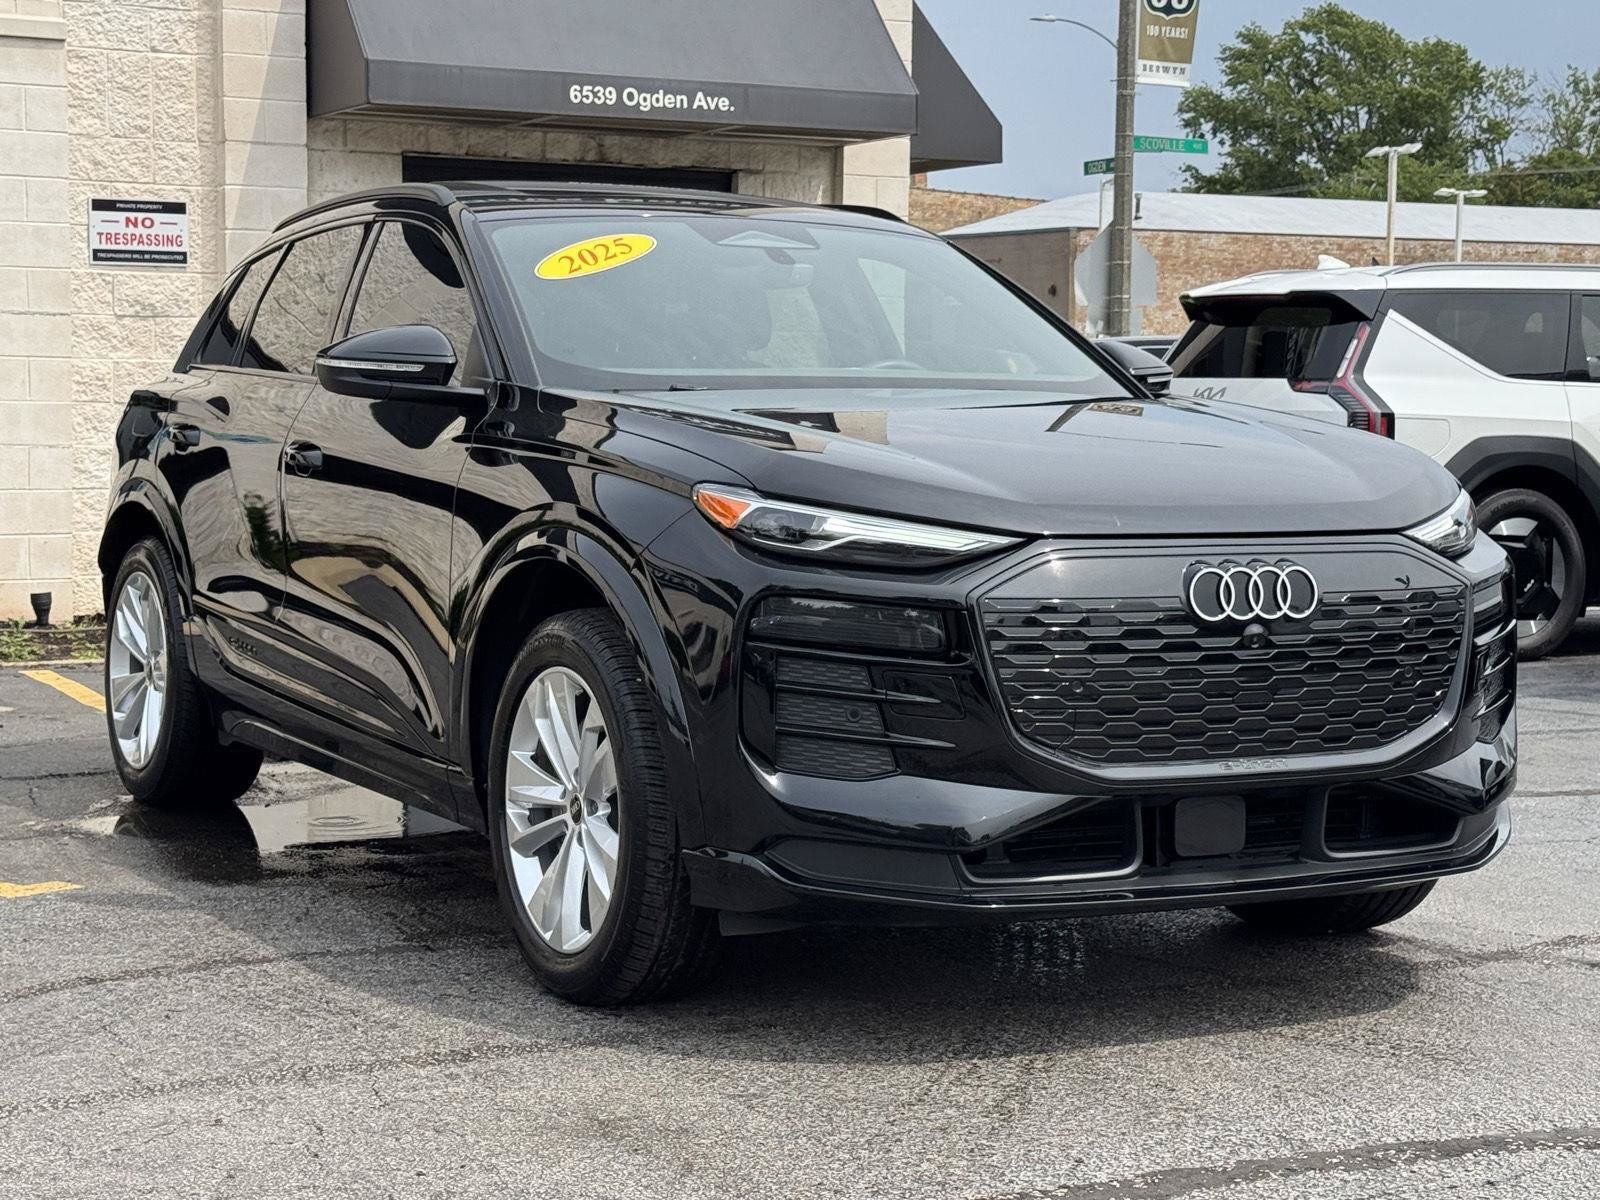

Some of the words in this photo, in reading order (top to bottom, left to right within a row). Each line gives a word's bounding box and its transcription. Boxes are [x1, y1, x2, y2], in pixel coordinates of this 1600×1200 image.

[1161, 26, 1189, 39] YEARS!
[1142, 64, 1186, 75] BERWYN
[569, 84, 617, 105] 6539
[622, 87, 688, 111] Ogden
[692, 91, 736, 112] Ave.
[1139, 137, 1185, 150] SCOVILLE
[125, 216, 155, 229] NO
[96, 232, 183, 247] TRESPASSING
[558, 238, 633, 274] 2025
